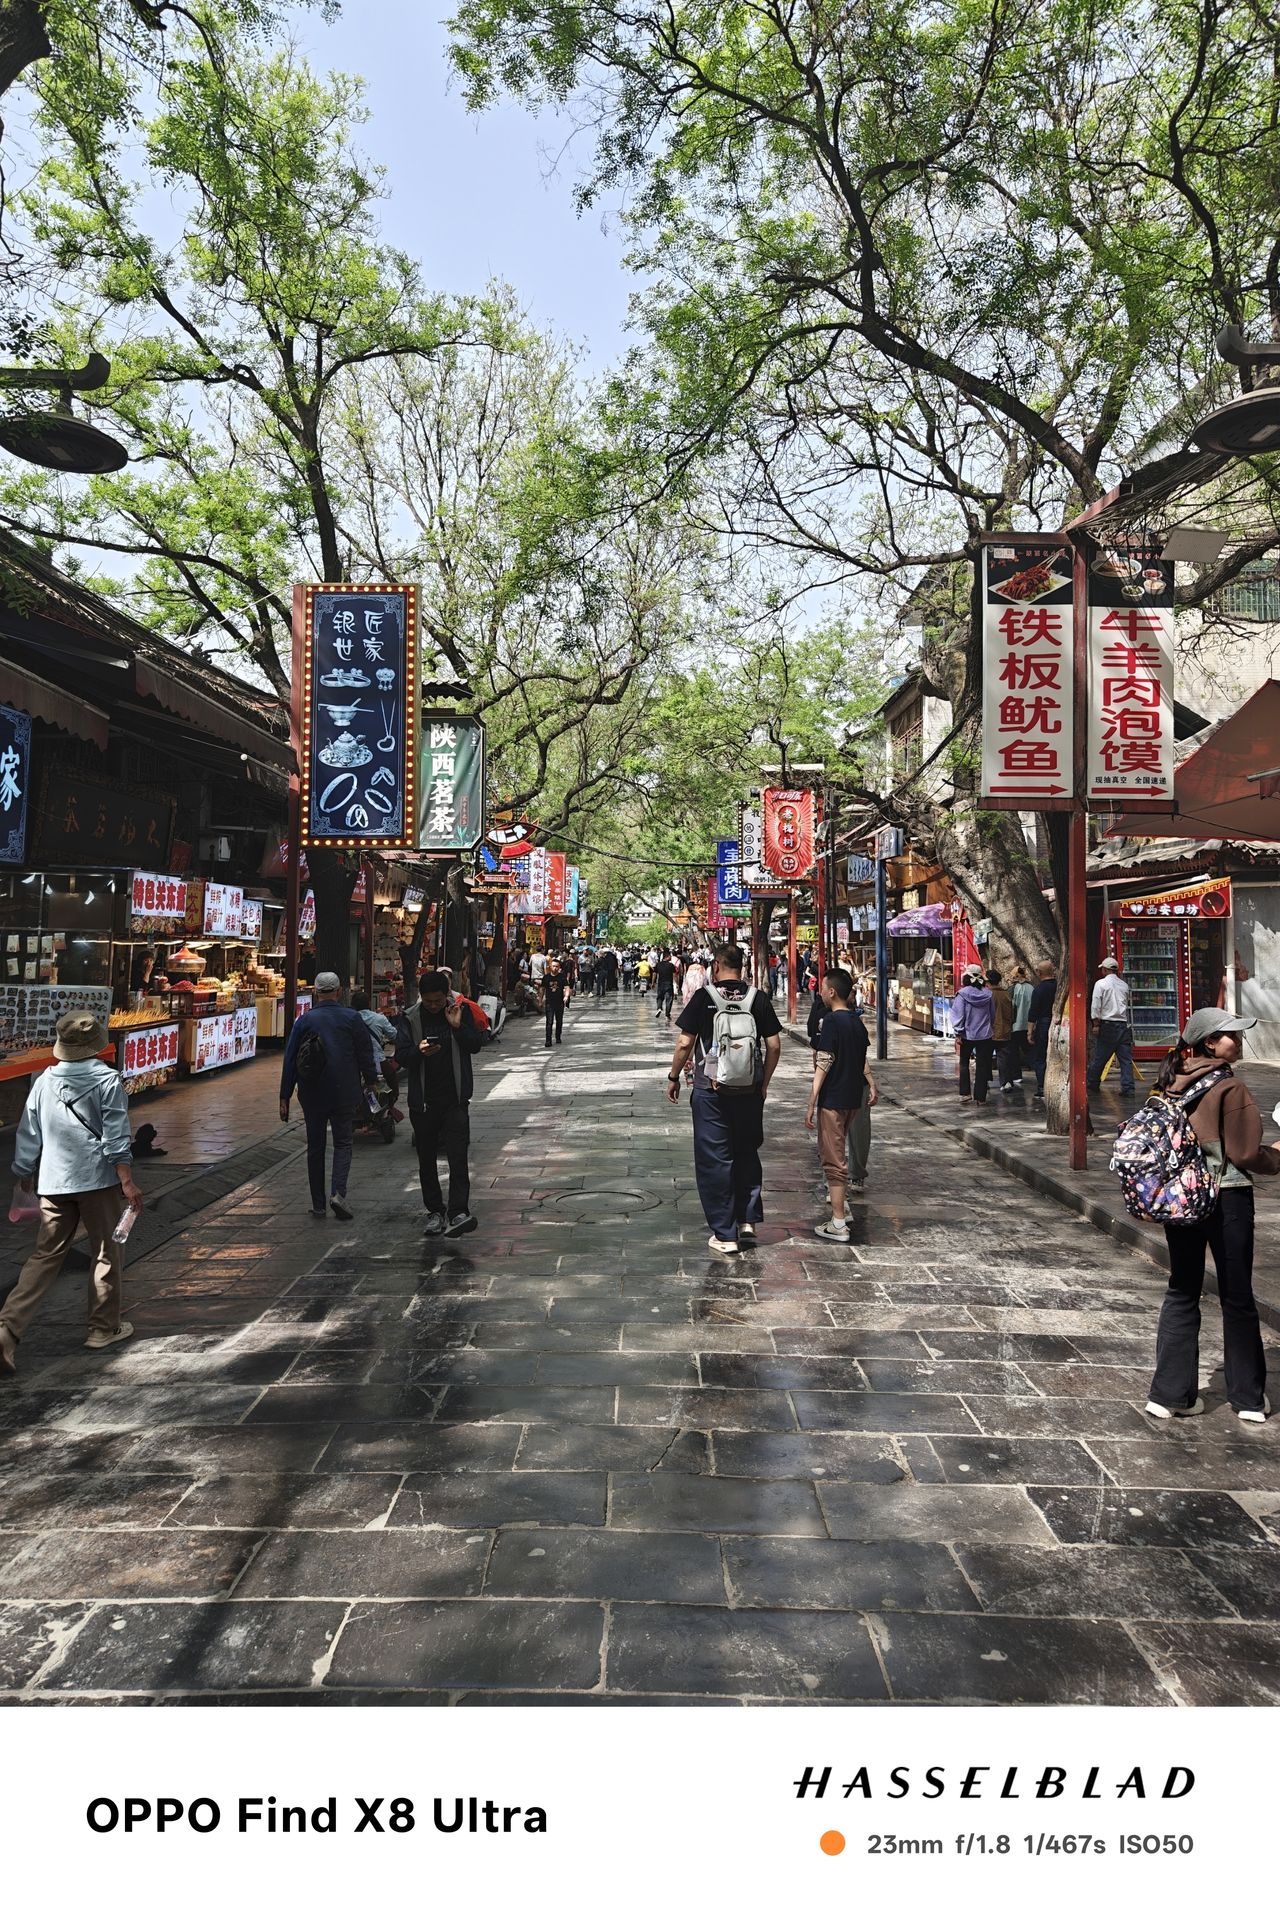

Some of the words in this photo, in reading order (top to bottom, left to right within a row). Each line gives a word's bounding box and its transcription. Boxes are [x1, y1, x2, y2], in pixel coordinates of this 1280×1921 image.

[332, 610, 385, 635] 银匠
[332, 637, 385, 661] 世家
[999, 608, 1062, 777] 铁板鱿鱼
[1100, 610, 1163, 773] 牛羊肉泡馍
[429, 722, 457, 833] 陕西茗茶
[1134, 776, 1167, 784] 全国速递
[132, 877, 186, 913] 特色关东煮
[1146, 903, 1199, 916] 西安回坊
[124, 1031, 178, 1071] 特色关东煮
